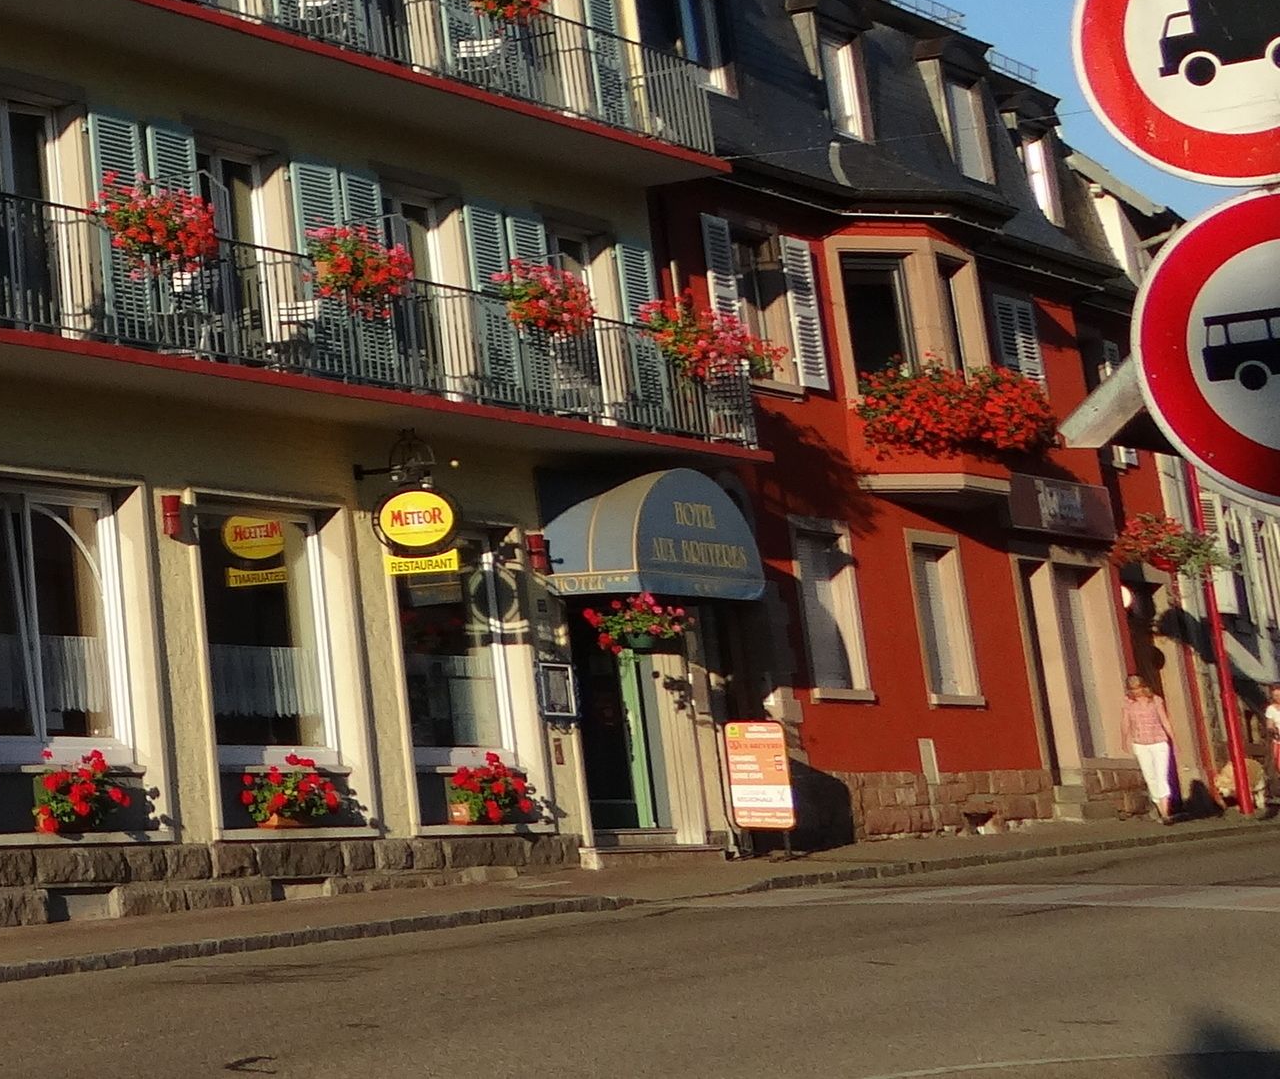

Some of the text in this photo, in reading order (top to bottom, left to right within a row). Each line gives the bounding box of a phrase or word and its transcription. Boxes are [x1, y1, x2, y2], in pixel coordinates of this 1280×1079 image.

[390, 507, 444, 527] METEOR
[673, 501, 716, 529] HOTEL
[652, 537, 677, 562] AUX
[391, 559, 453, 573] RESTAURANT
[555, 575, 606, 592] HOTEL
